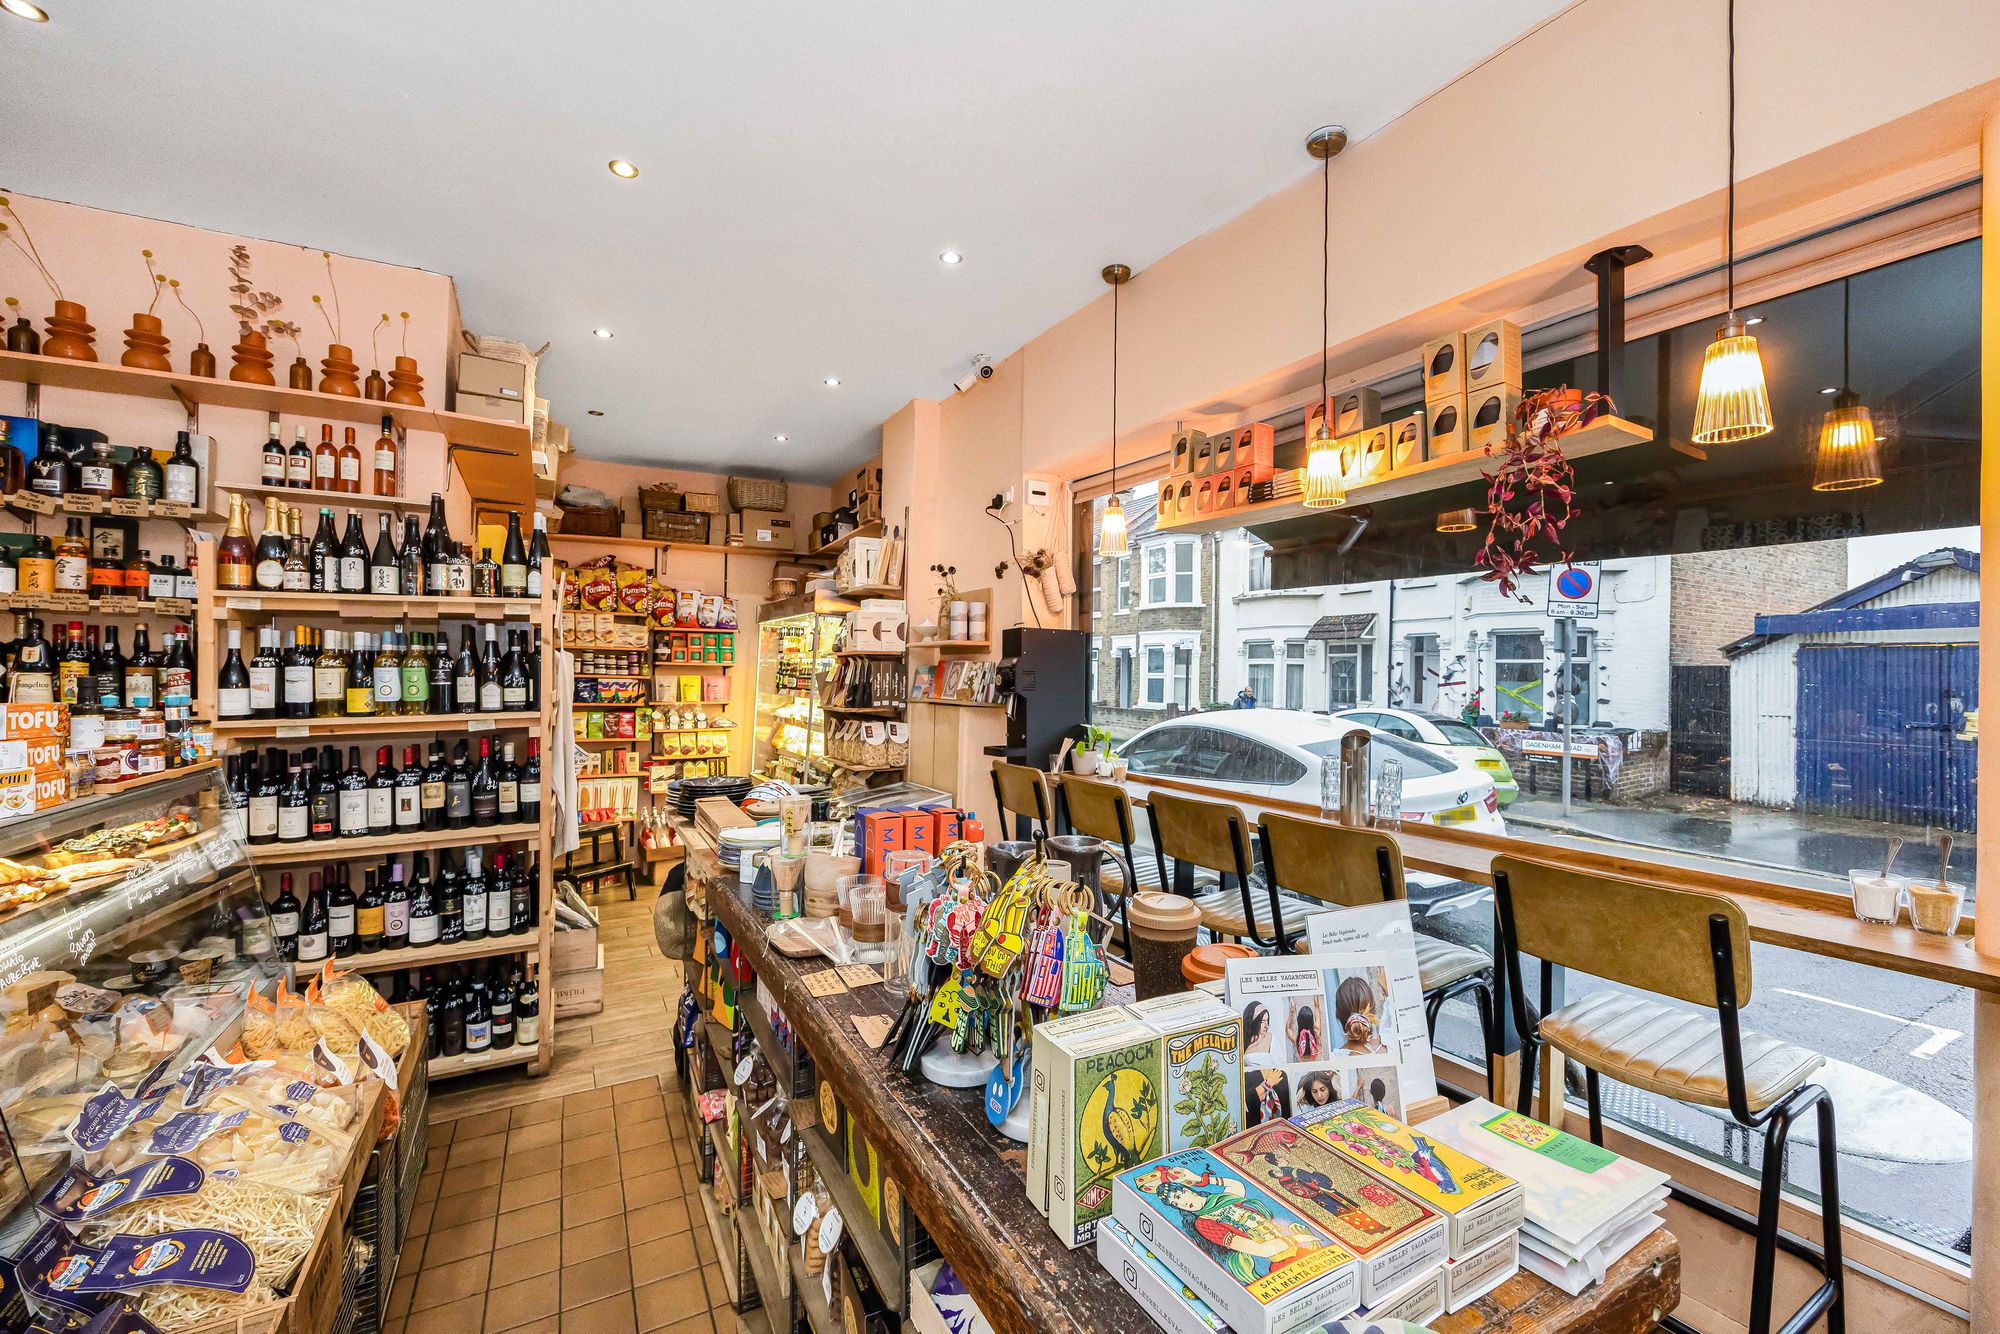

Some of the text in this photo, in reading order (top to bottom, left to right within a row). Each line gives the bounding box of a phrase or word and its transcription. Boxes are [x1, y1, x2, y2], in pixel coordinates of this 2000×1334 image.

[8, 710, 59, 731] TOFU
[28, 744, 60, 766] TOFU
[1526, 742, 1560, 750] DAGENHAM
[36, 778, 65, 801] TOFU
[987, 959, 1002, 973] THIS
[997, 949, 1009, 961] GOT
[1280, 973, 1317, 981] VAGABONDES
[1087, 1043, 1154, 1074] PEACOCK
[1170, 1034, 1236, 1063] THE MELATTI
[1168, 1150, 1203, 1163] DANCING
[1181, 1155, 1206, 1165] GIRL
[1076, 1229, 1097, 1243] MAT
[1374, 1229, 1443, 1271] LES BELLES VAGABONDES
[1153, 1238, 1230, 1312] LESBELLESVAGABONDES
[1260, 1248, 1336, 1289] SAFETY MATCHES
[1283, 1272, 1311, 1289] MEHTA
[1310, 1252, 1350, 1273] CALCUTTA
[1273, 1278, 1353, 1324] LES BELLES VAGABONDES
